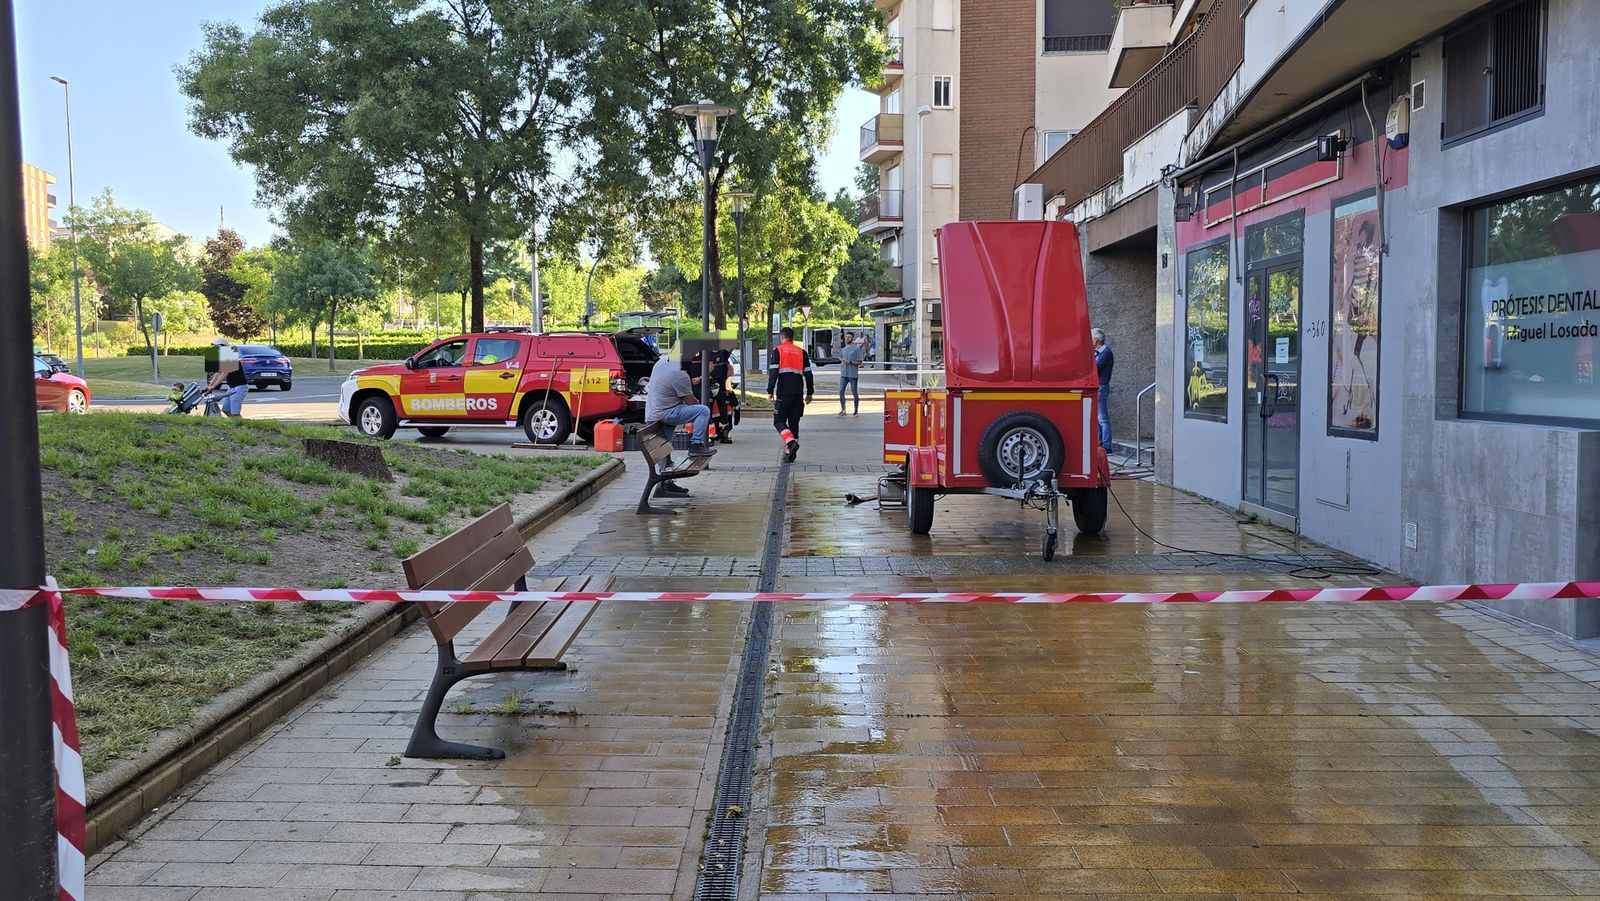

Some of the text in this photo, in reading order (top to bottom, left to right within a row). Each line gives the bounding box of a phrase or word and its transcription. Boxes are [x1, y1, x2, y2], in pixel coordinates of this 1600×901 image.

[1491, 290, 1600, 317] PRÓTESIS DENTAL
[1506, 320, 1598, 342] Miguel Losada
[505, 361, 520, 369] V-4
[411, 397, 498, 411] BOMBEROS
